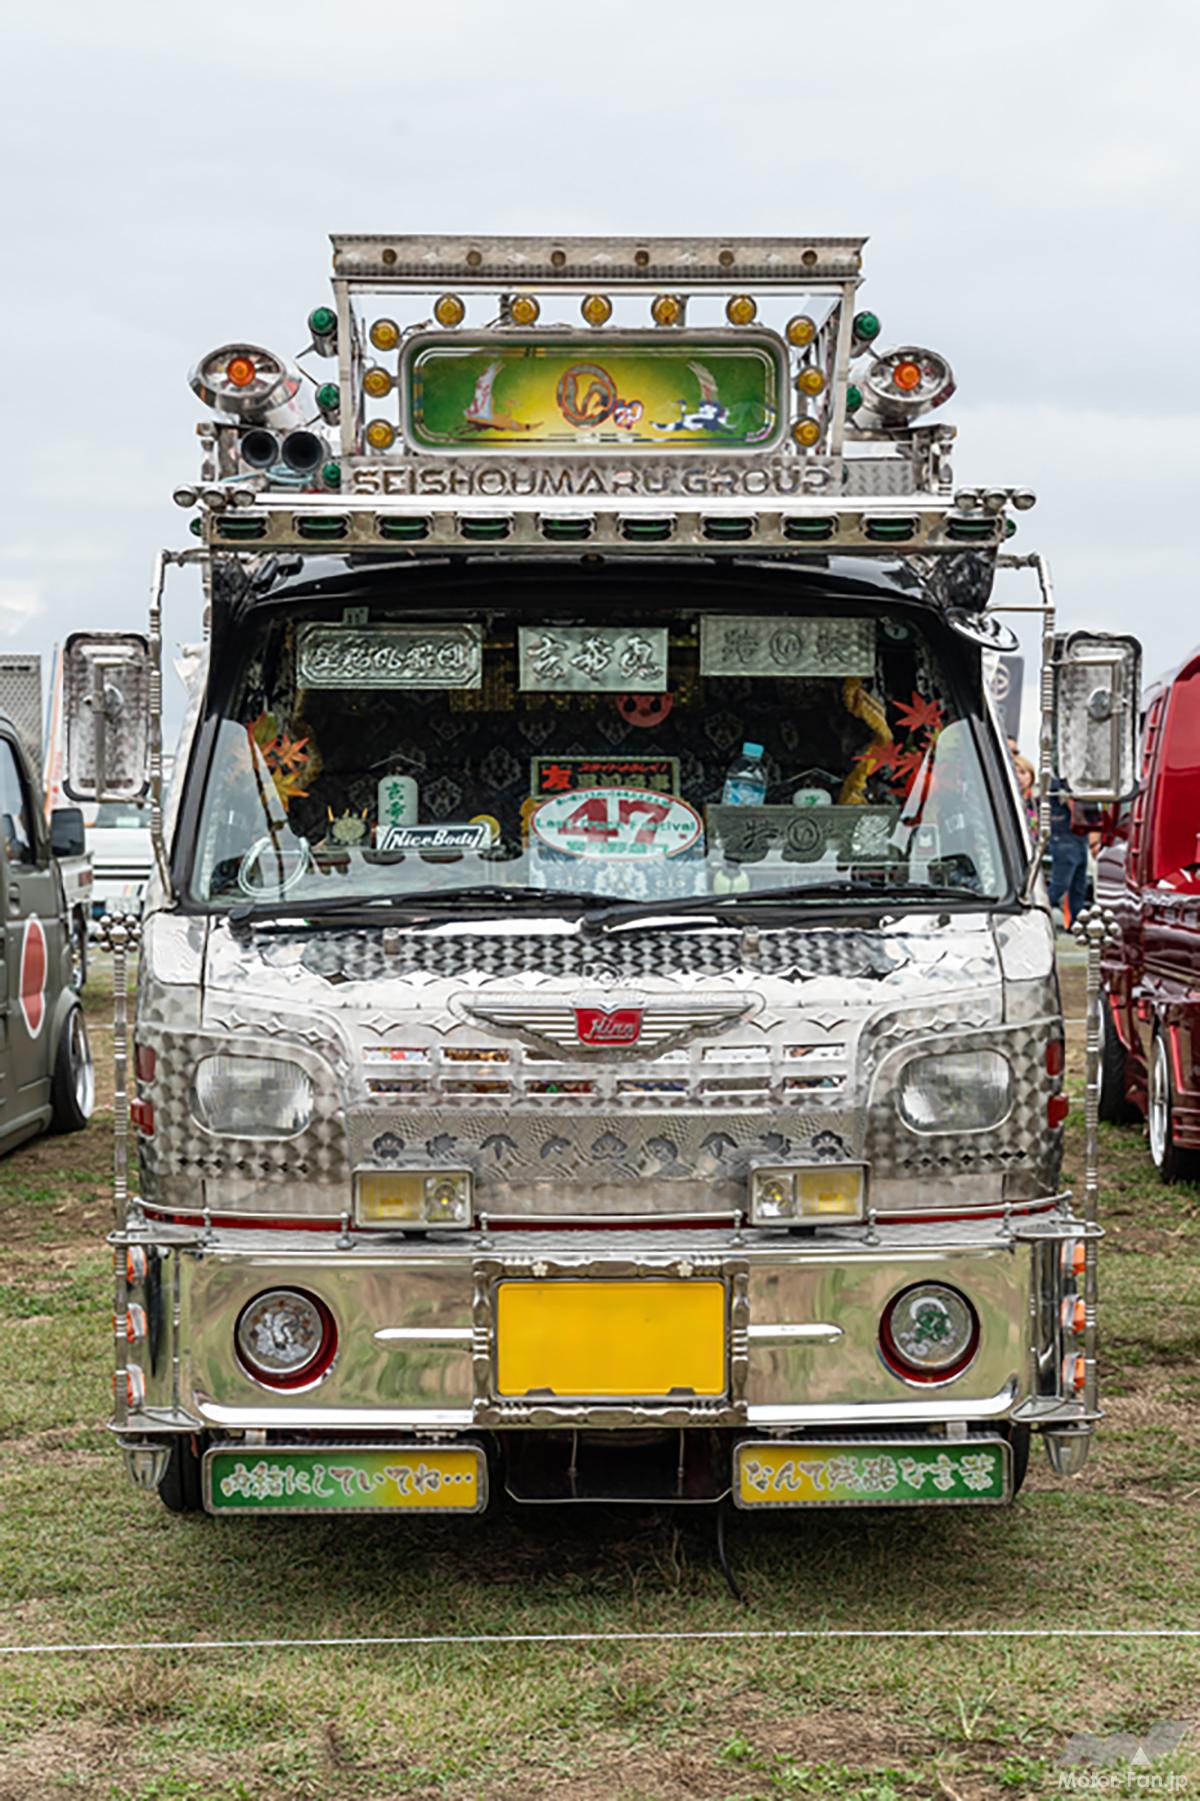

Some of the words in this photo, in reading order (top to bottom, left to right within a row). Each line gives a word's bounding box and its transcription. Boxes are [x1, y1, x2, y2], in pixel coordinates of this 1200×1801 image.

[352, 468, 668, 496] SEISHOUMARU
[681, 466, 831, 495] GROUP
[541, 764, 572, 790] 友
[558, 798, 671, 844] 47
[390, 829, 480, 849] NiceBody
